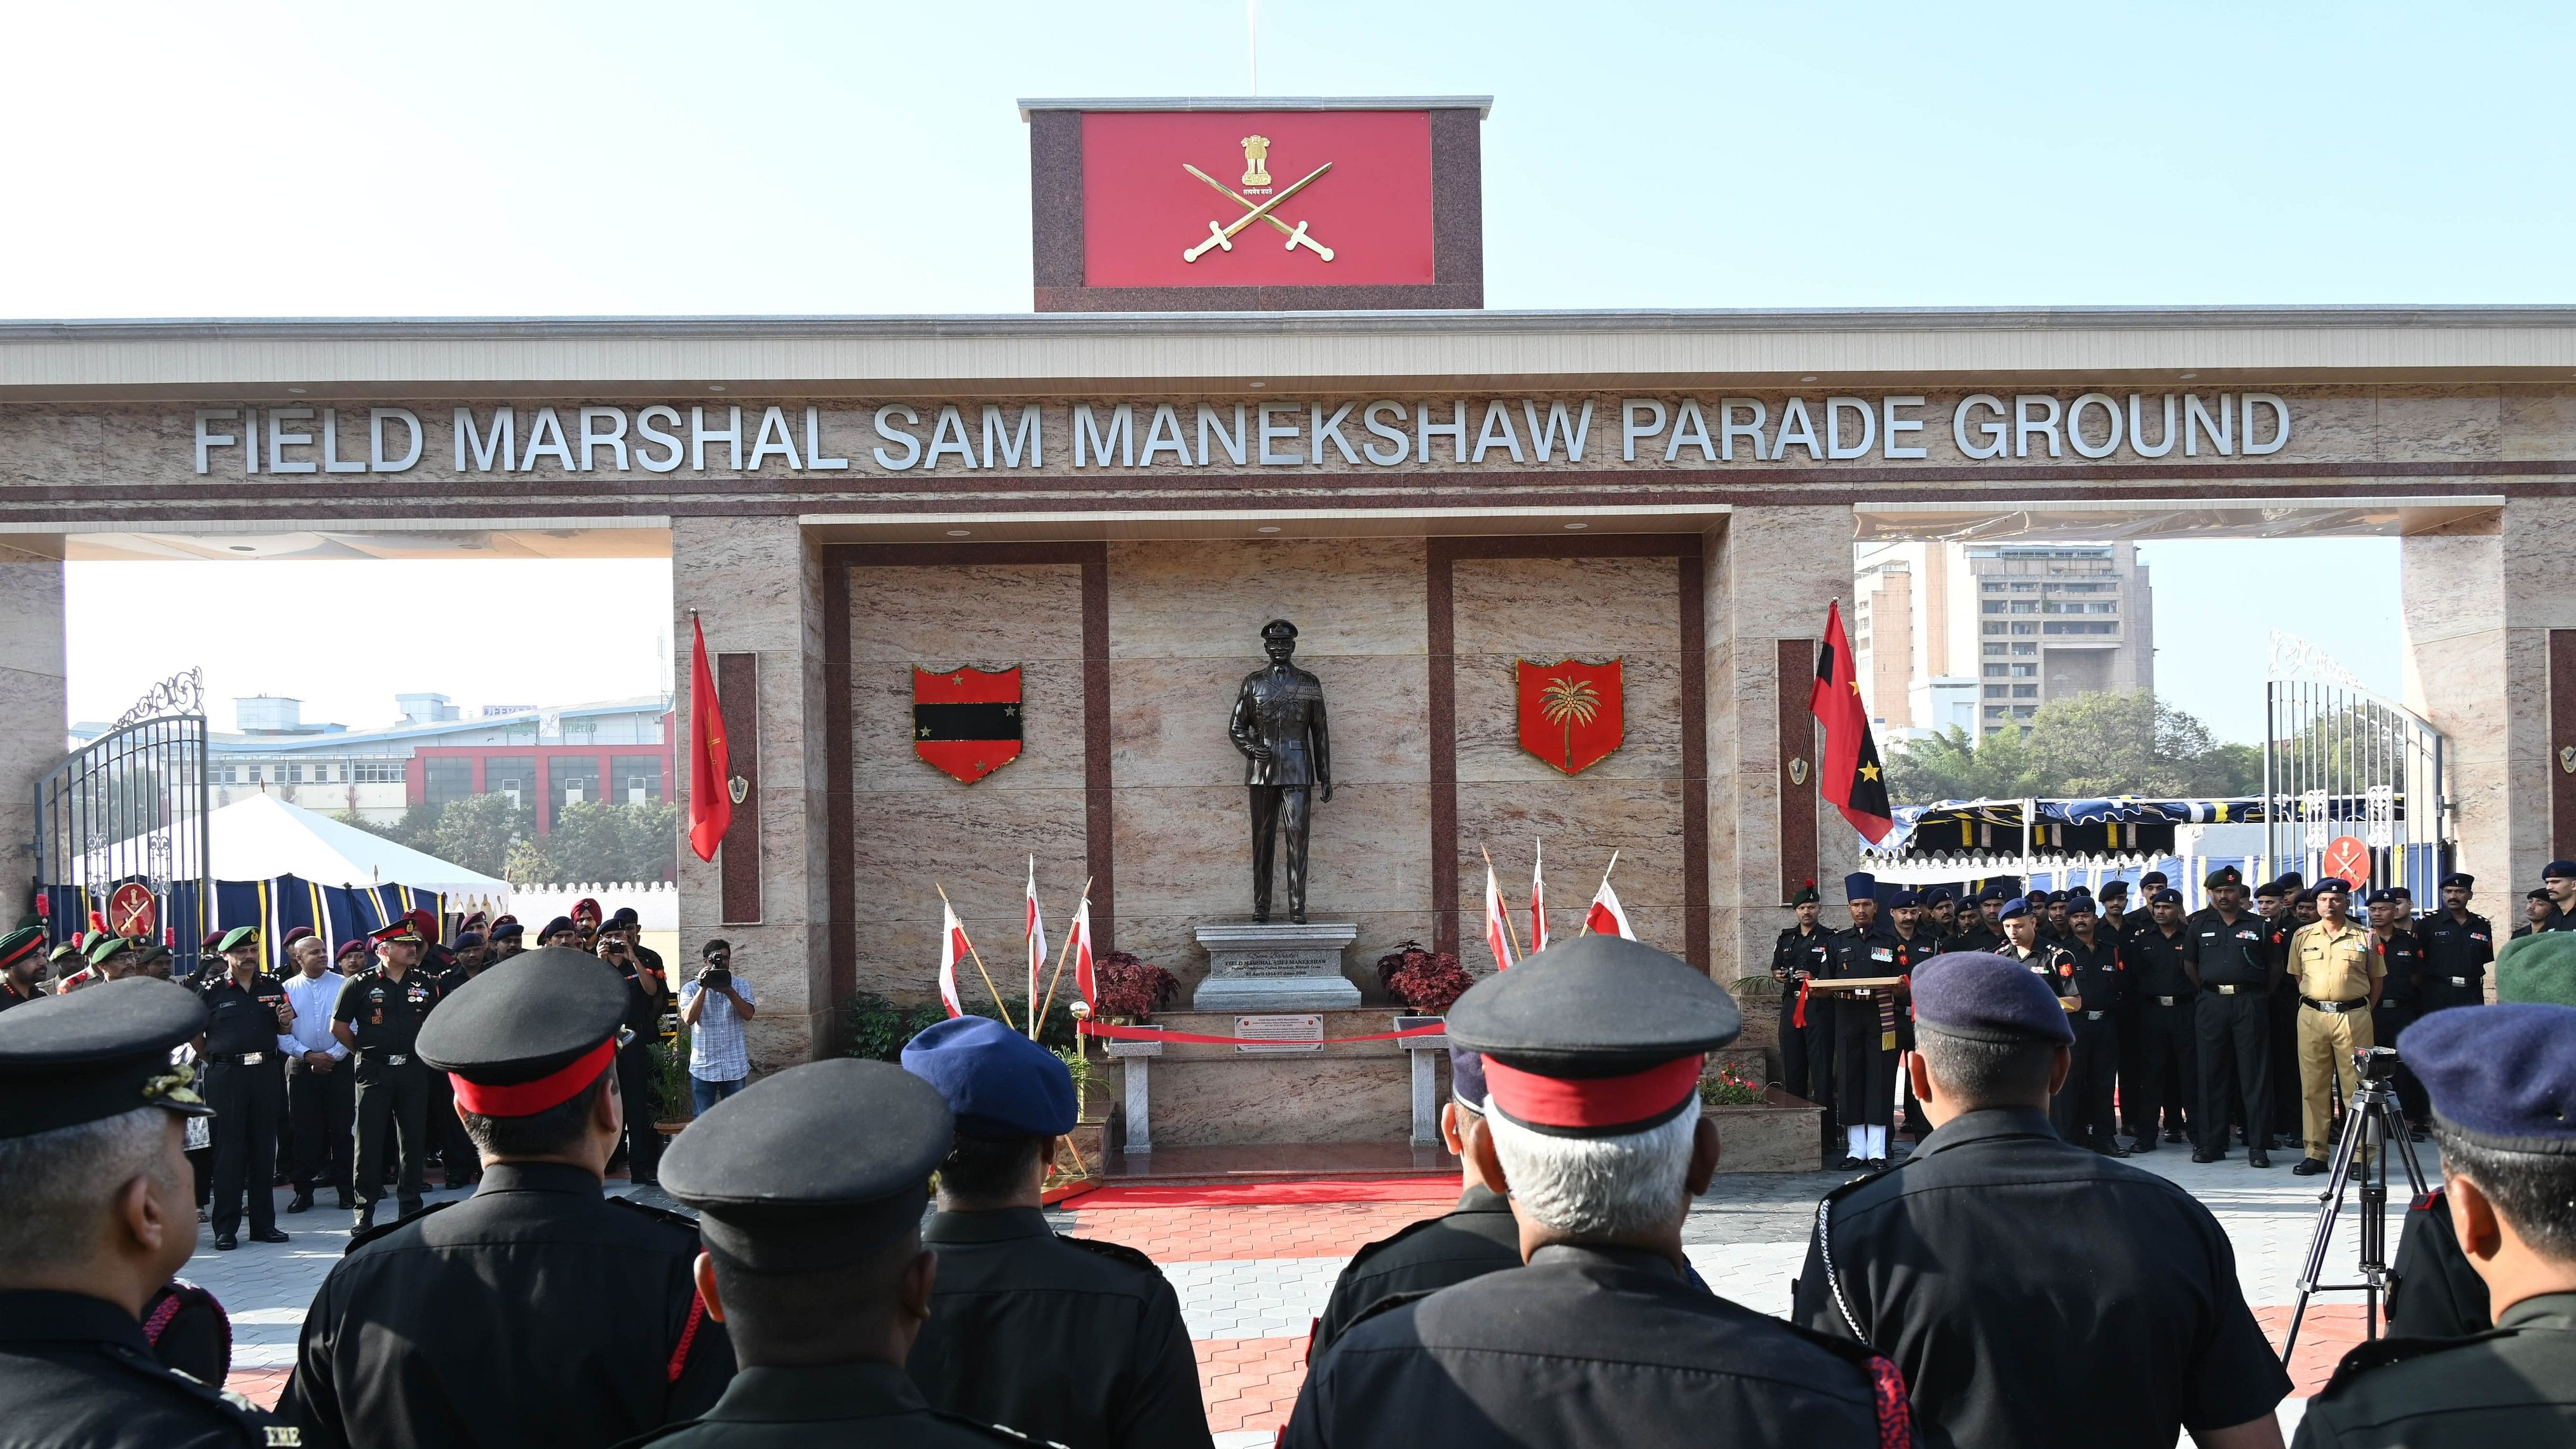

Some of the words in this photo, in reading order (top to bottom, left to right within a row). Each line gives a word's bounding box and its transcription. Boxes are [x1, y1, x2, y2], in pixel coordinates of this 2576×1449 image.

[195, 408, 423, 473] FIELD
[454, 405, 848, 472] MARSHAL
[873, 404, 1042, 471] SAM
[1073, 398, 1594, 468] MANEKSHAW
[1621, 395, 1927, 461] PARADE
[1952, 392, 2291, 459] GROUND
